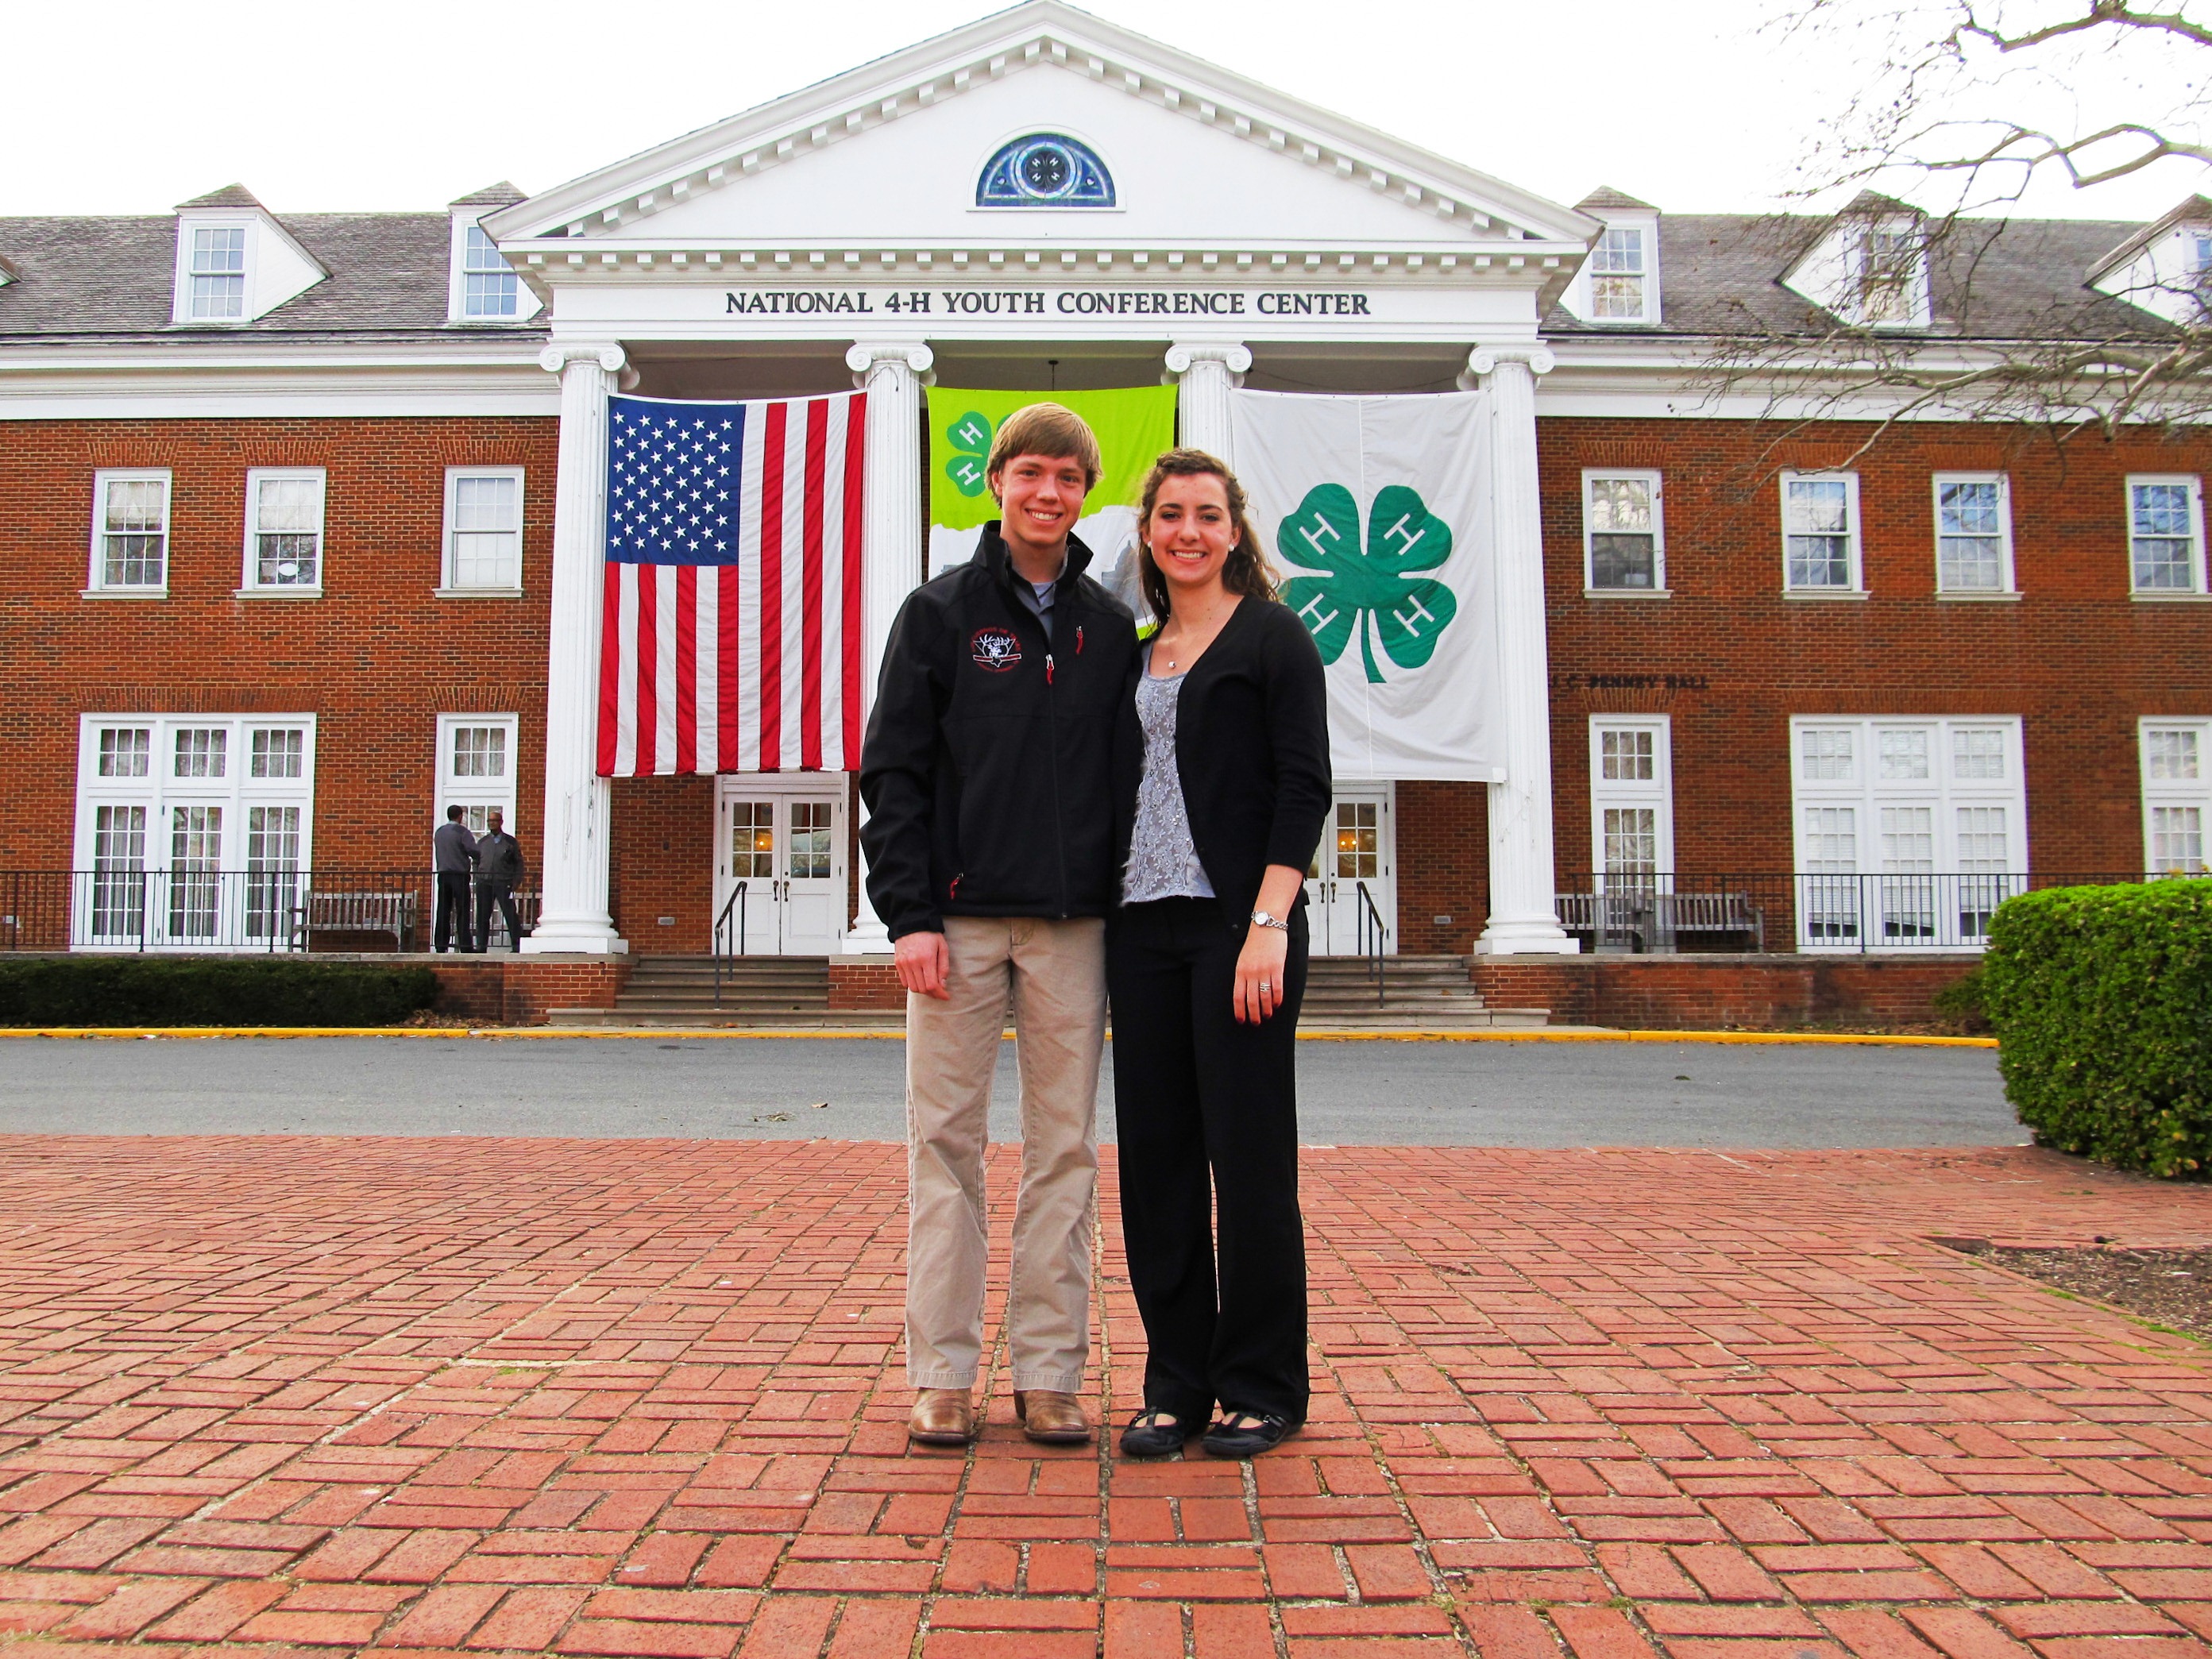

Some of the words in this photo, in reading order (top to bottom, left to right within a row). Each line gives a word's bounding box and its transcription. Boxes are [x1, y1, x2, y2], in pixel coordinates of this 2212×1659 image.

[1032, 158, 1040, 168] H
[1049, 157, 1059, 167] H
[1032, 172, 1041, 182] H
[1051, 172, 1060, 181] H
[726, 292, 874, 314] NATIONAL
[884, 292, 932, 313] 4-H
[942, 292, 1045, 314] YOUTH
[1057, 292, 1245, 314] CONFERENCE
[1257, 293, 1371, 315] CENTER
[959, 422, 983, 446] H
[956, 461, 982, 486] H
[1299, 511, 1341, 555] H
[1384, 513, 1426, 556] H
[1297, 592, 1339, 635] H
[1392, 594, 1435, 638] H
[1589, 675, 1656, 689] PENNEY
[1666, 675, 1709, 689] HALL
